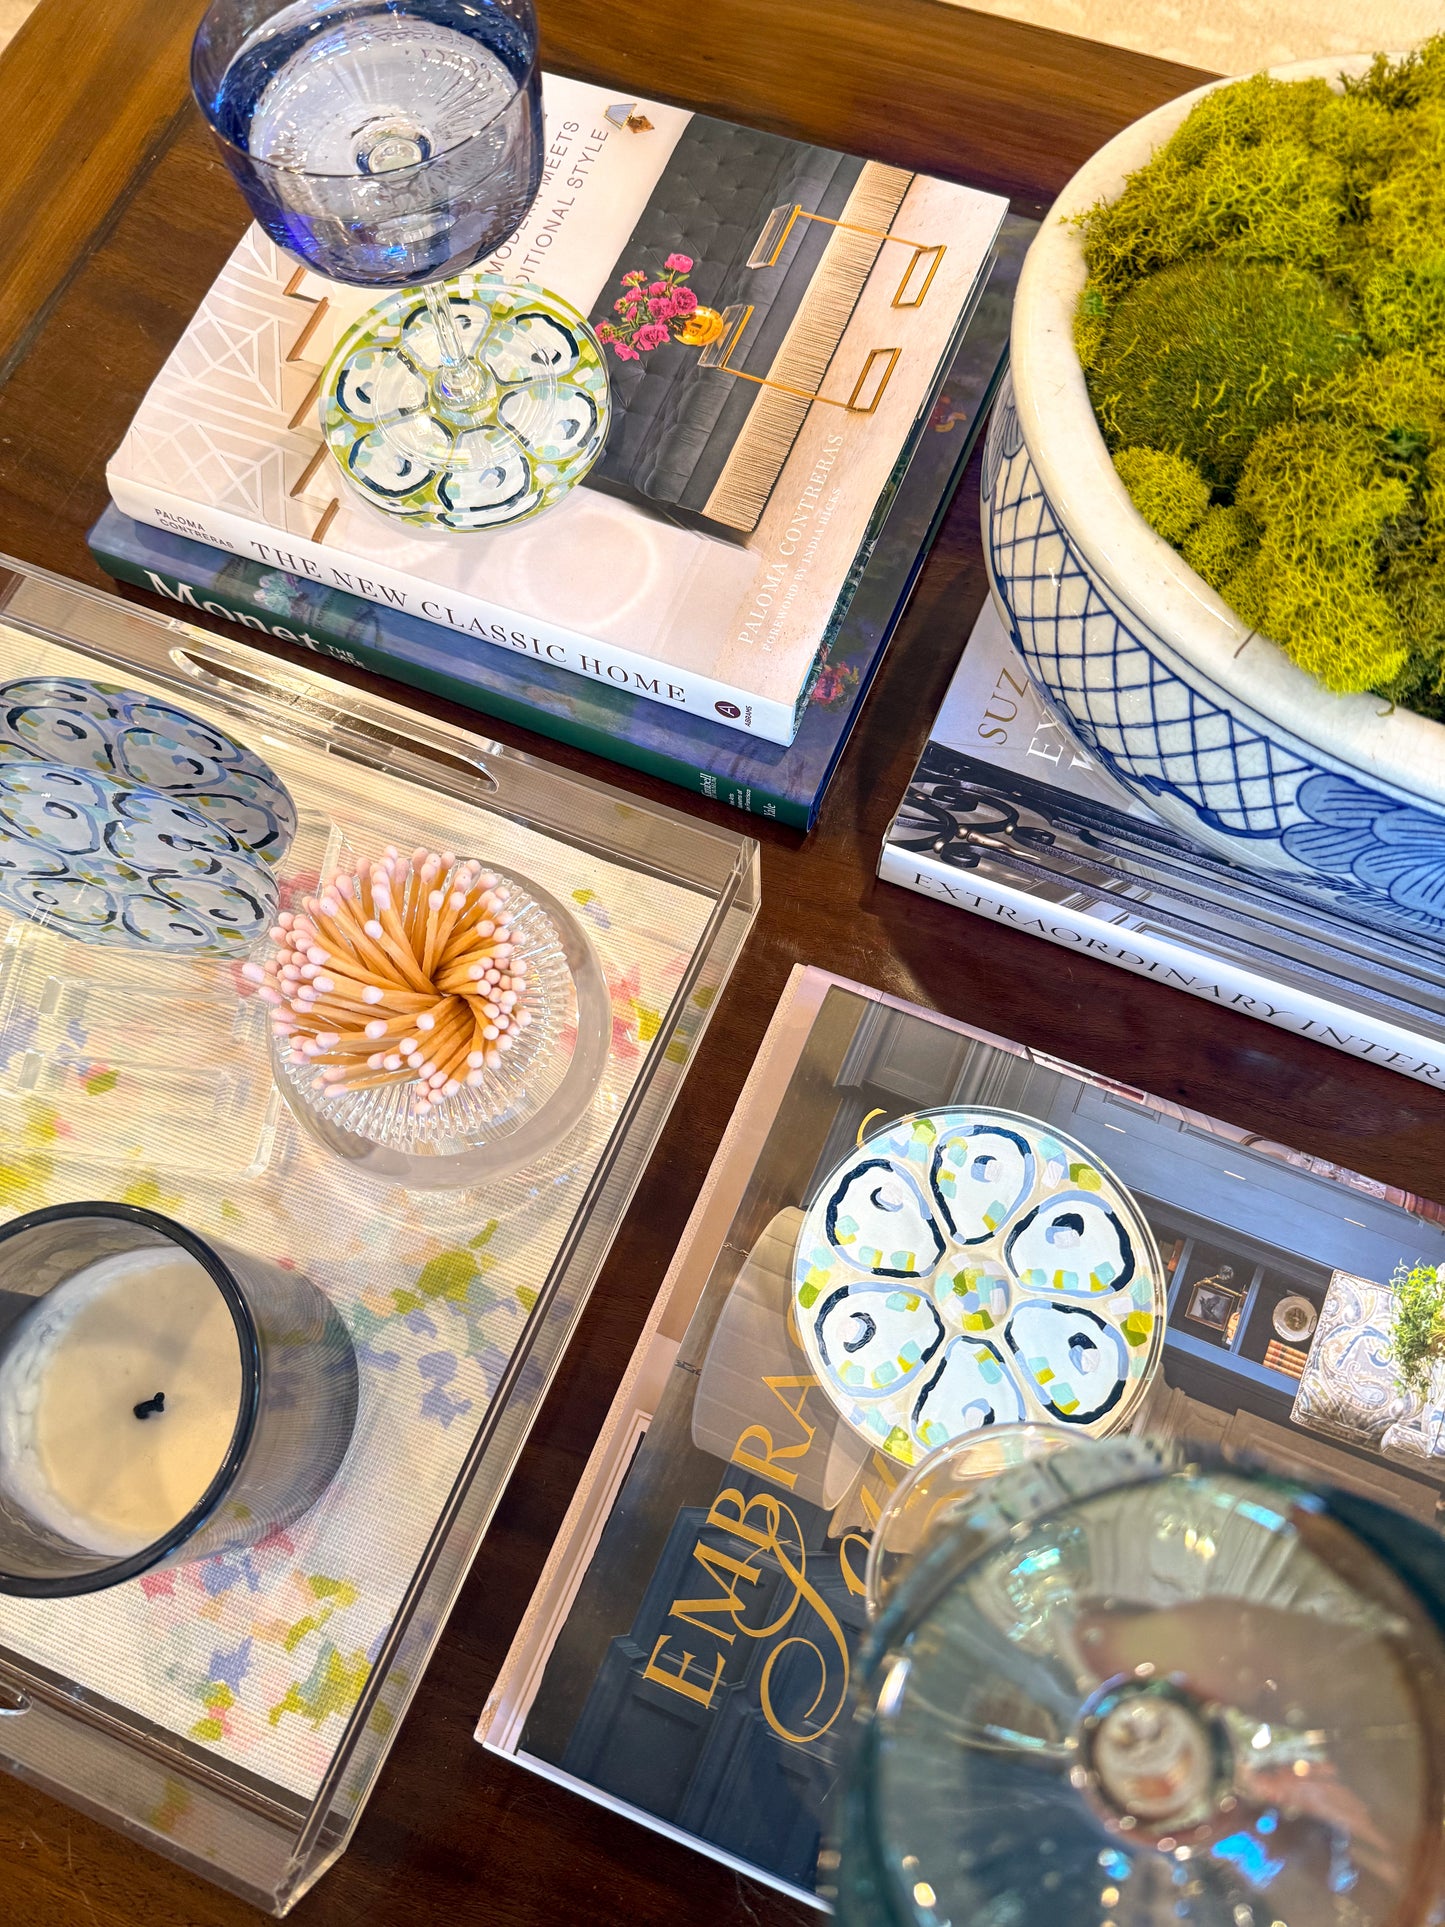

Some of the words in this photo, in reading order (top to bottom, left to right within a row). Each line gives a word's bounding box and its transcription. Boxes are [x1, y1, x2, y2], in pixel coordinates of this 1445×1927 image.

[484, 195, 543, 275] MOD
[542, 121, 580, 186] MEETS
[567, 128, 609, 189] STYLE
[154, 508, 206, 532] PALOMA
[159, 518, 235, 549] CONTRERAS
[737, 563, 789, 645] PALOMA
[779, 433, 844, 556] CONTRERAS
[762, 584, 799, 653] FOREWORD
[795, 566, 809, 583] BY
[802, 528, 825, 565] INDIA
[818, 487, 841, 526] HICKS
[143, 569, 320, 653] Monet
[250, 541, 323, 579] THE
[330, 567, 409, 608] NEW
[421, 600, 567, 663] CLASSIC
[578, 653, 687, 703] HOME
[744, 705, 753, 728] ABRAMS
[977, 651, 1030, 745] SUZ
[914, 871, 1296, 1021] EXTRAORDINARY
[1300, 1020, 1445, 1083] INTER
[642, 1298, 824, 1710] EMBRA
